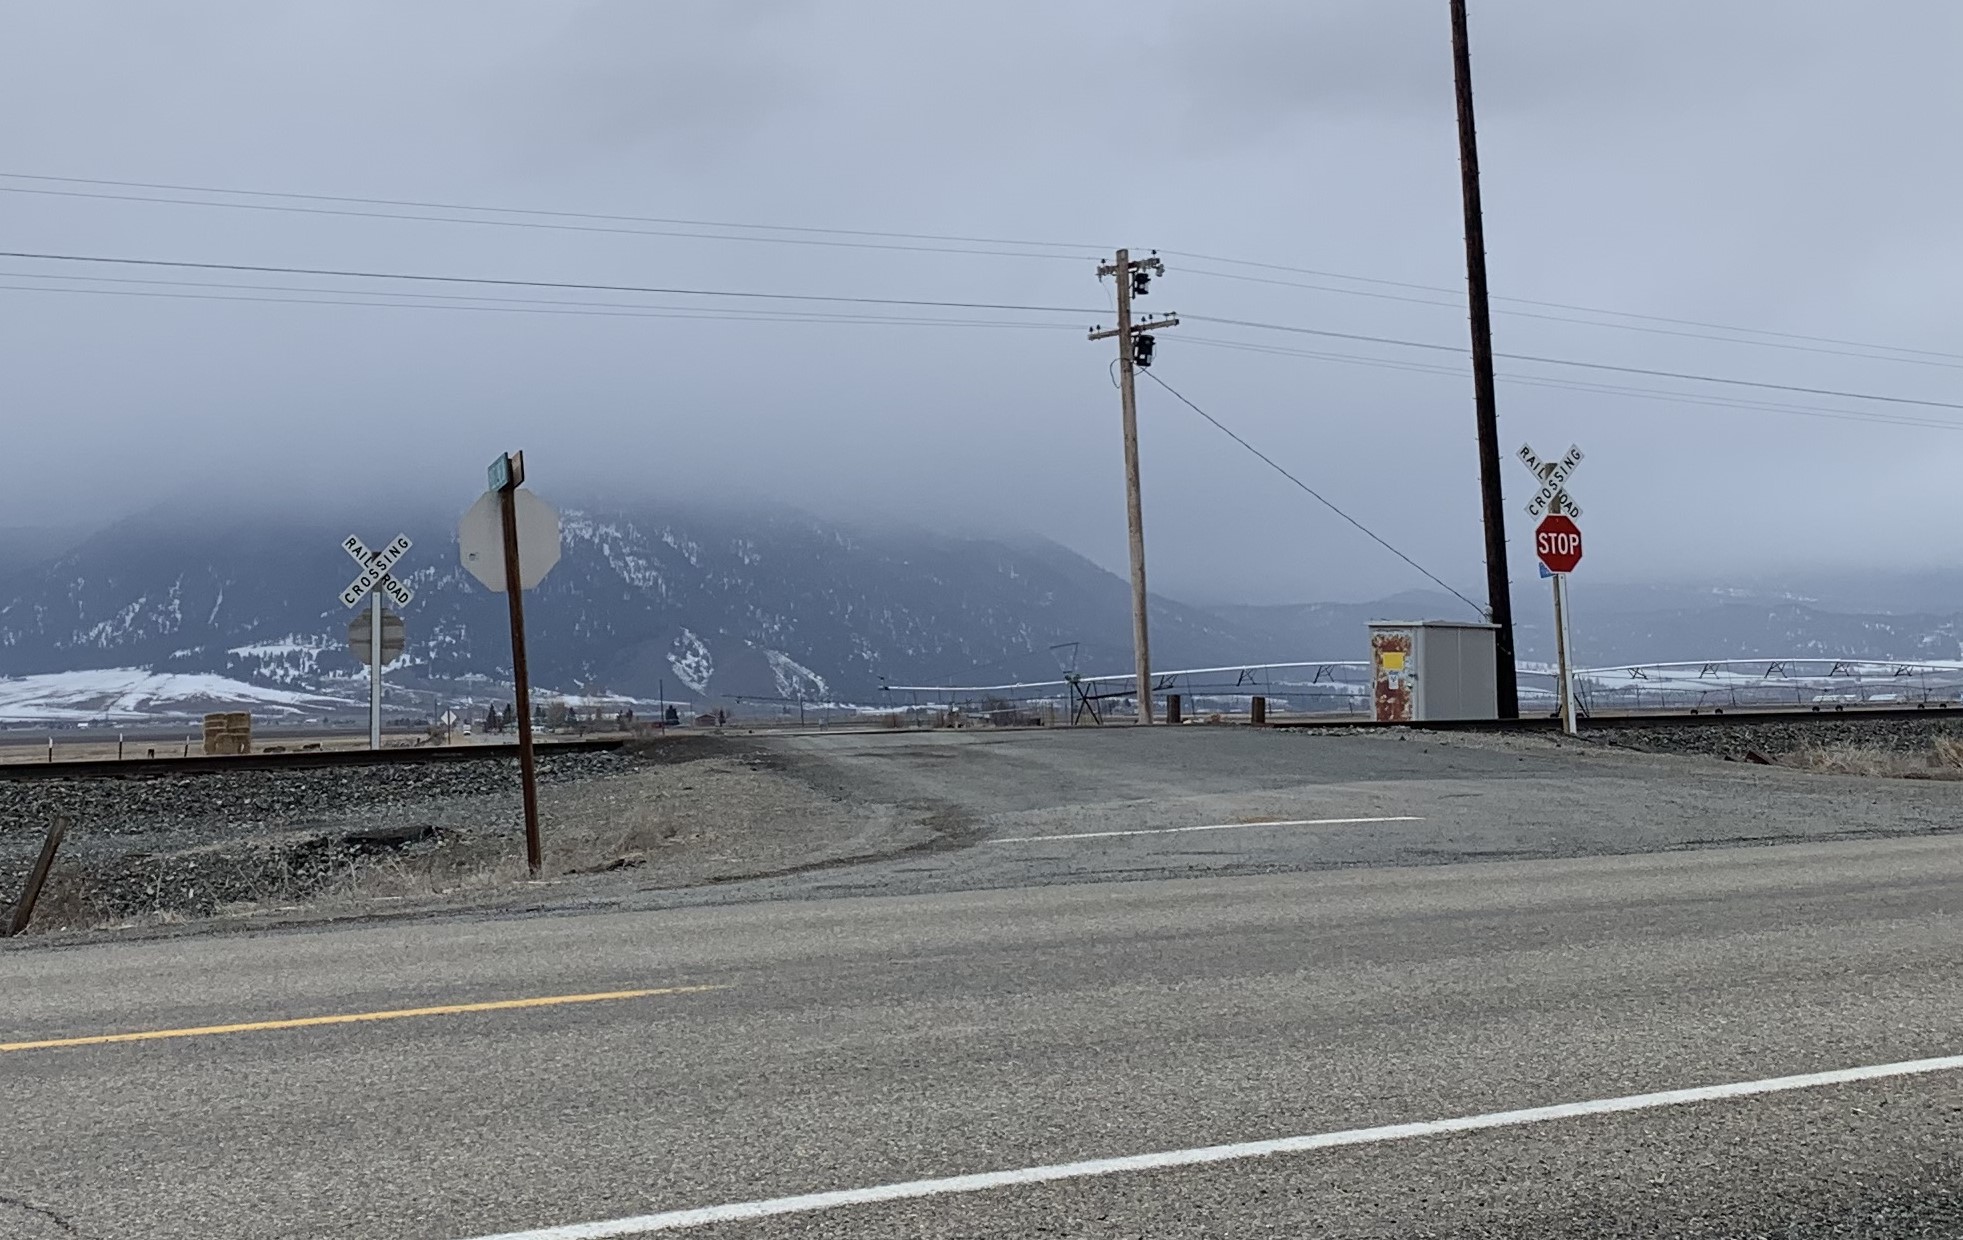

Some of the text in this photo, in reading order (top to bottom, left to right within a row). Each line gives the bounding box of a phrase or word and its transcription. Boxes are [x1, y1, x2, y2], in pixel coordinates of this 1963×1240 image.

[1520, 446, 1545, 480] RAIL
[1529, 448, 1581, 516] CROSSING
[344, 538, 409, 604] CROSSING
[345, 537, 409, 604] RAIL ROAD
[1538, 532, 1579, 555] STOP
